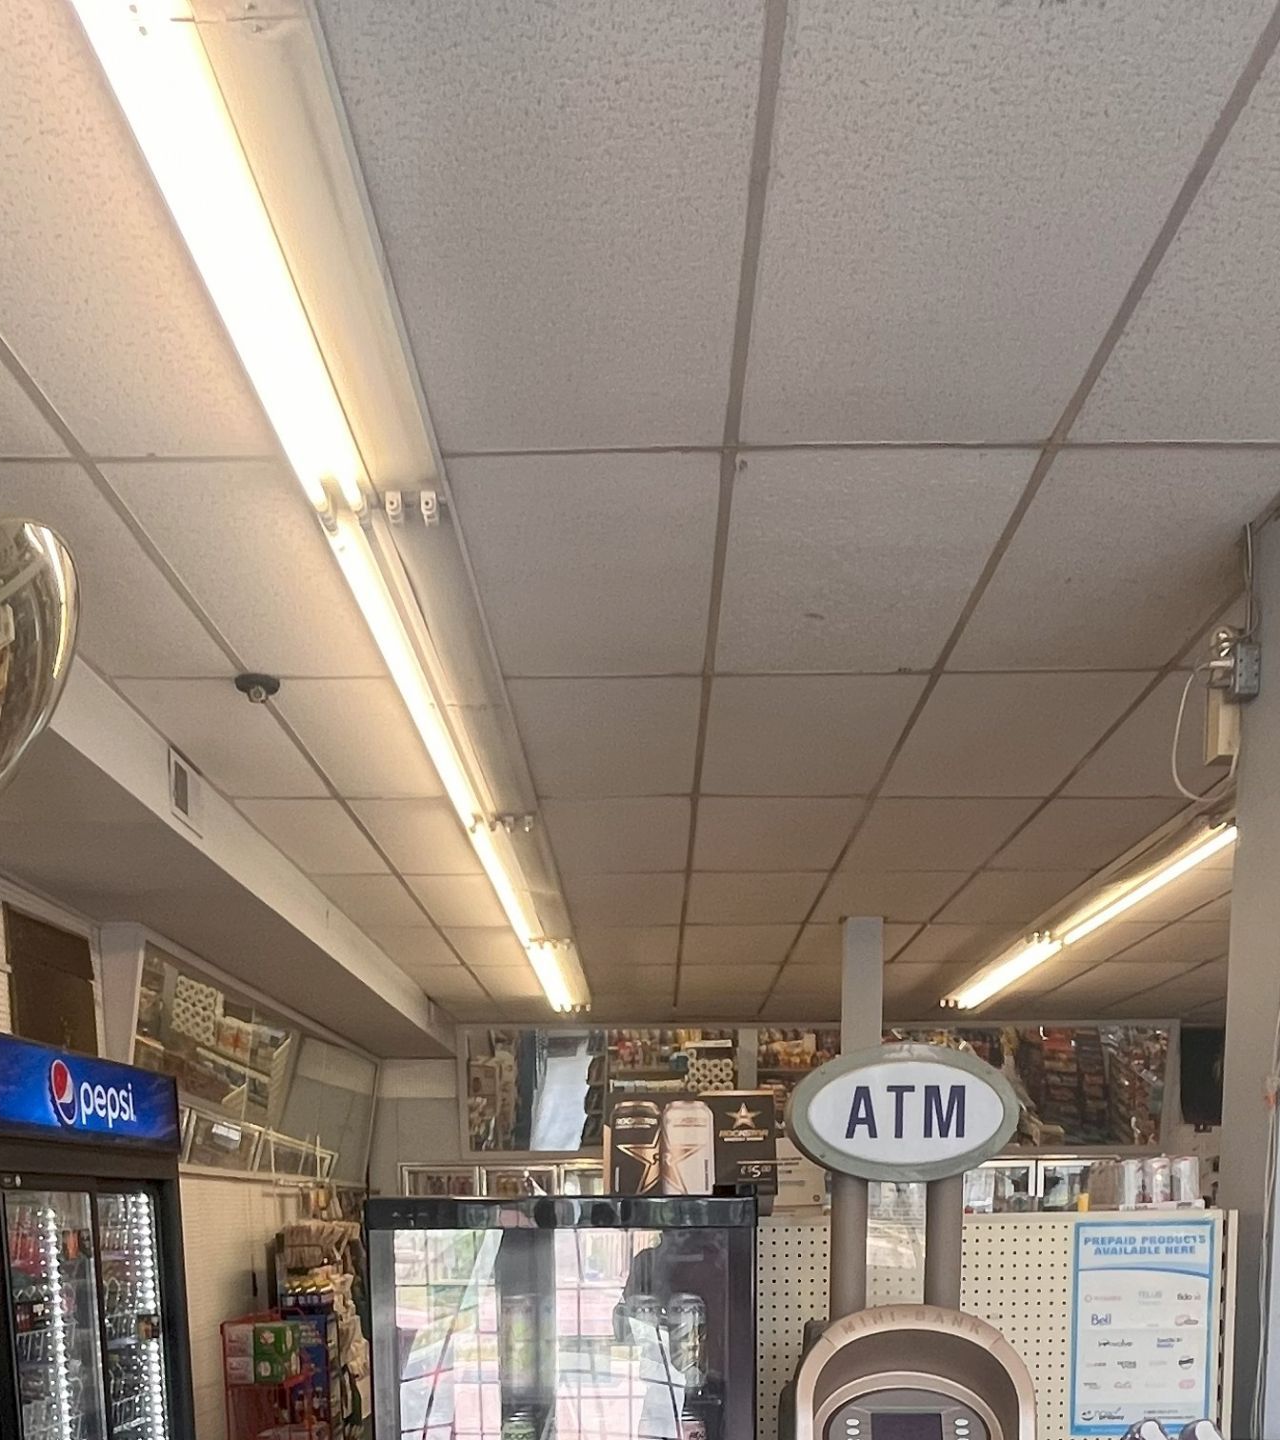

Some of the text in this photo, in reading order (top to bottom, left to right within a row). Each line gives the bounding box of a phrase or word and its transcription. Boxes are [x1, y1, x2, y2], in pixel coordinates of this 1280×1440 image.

[79, 1079, 137, 1127] pepsi
[844, 1084, 967, 1140] ATM
[1083, 1235, 1207, 1246] PREPAID PRODUCTS
[1093, 1245, 1196, 1256] AVAILABLE HERE
